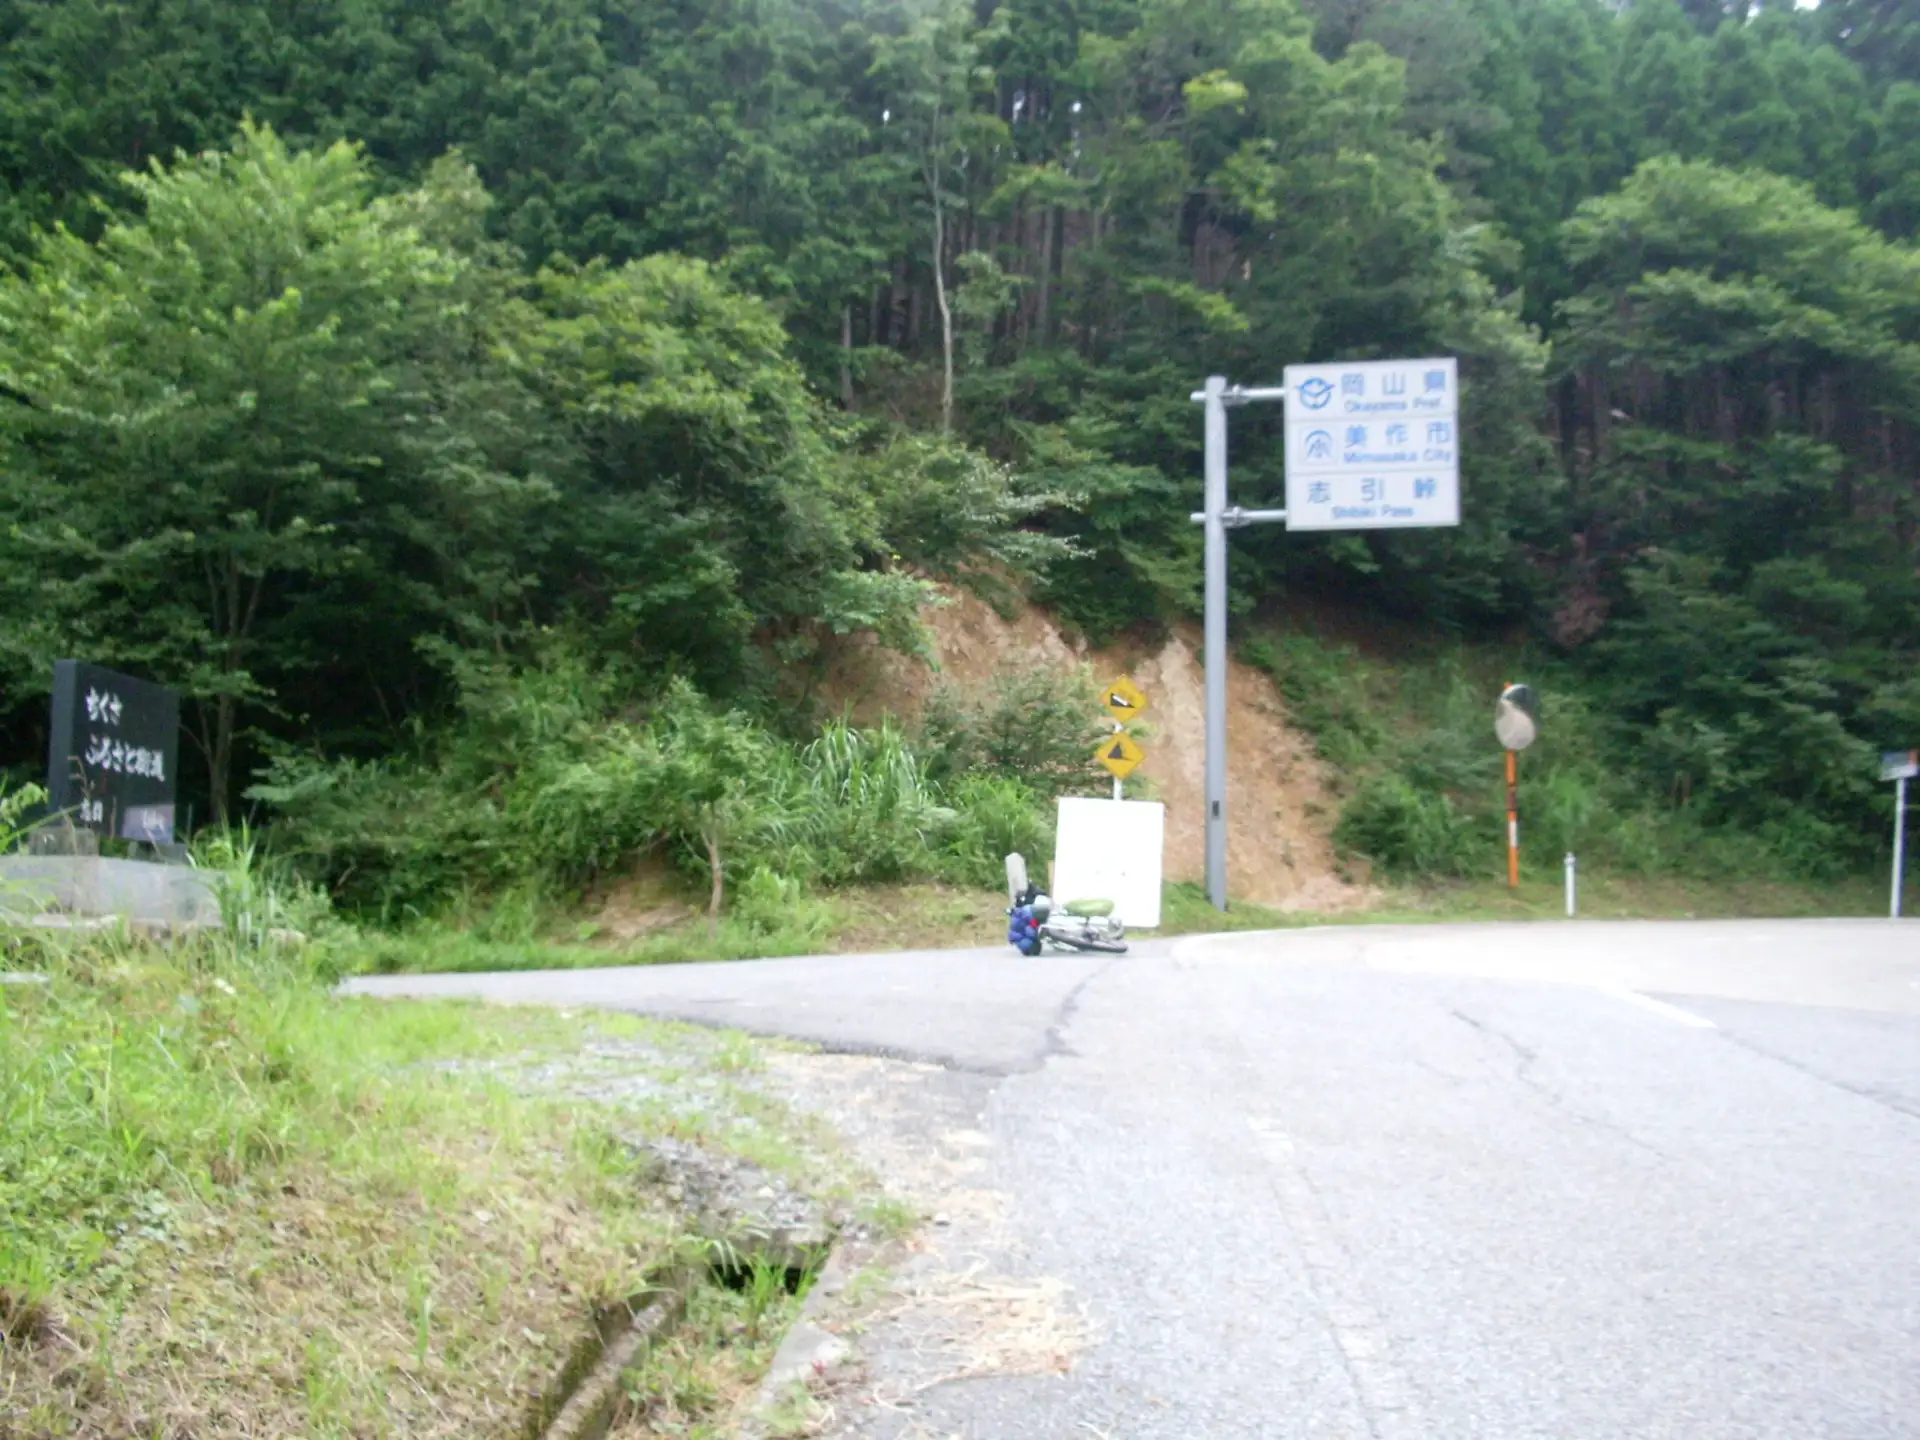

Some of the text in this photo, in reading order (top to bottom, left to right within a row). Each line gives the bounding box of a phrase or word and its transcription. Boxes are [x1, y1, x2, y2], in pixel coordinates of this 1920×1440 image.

[1342, 370, 1446, 396] 岡山
[85, 734, 165, 782] ふるさと
